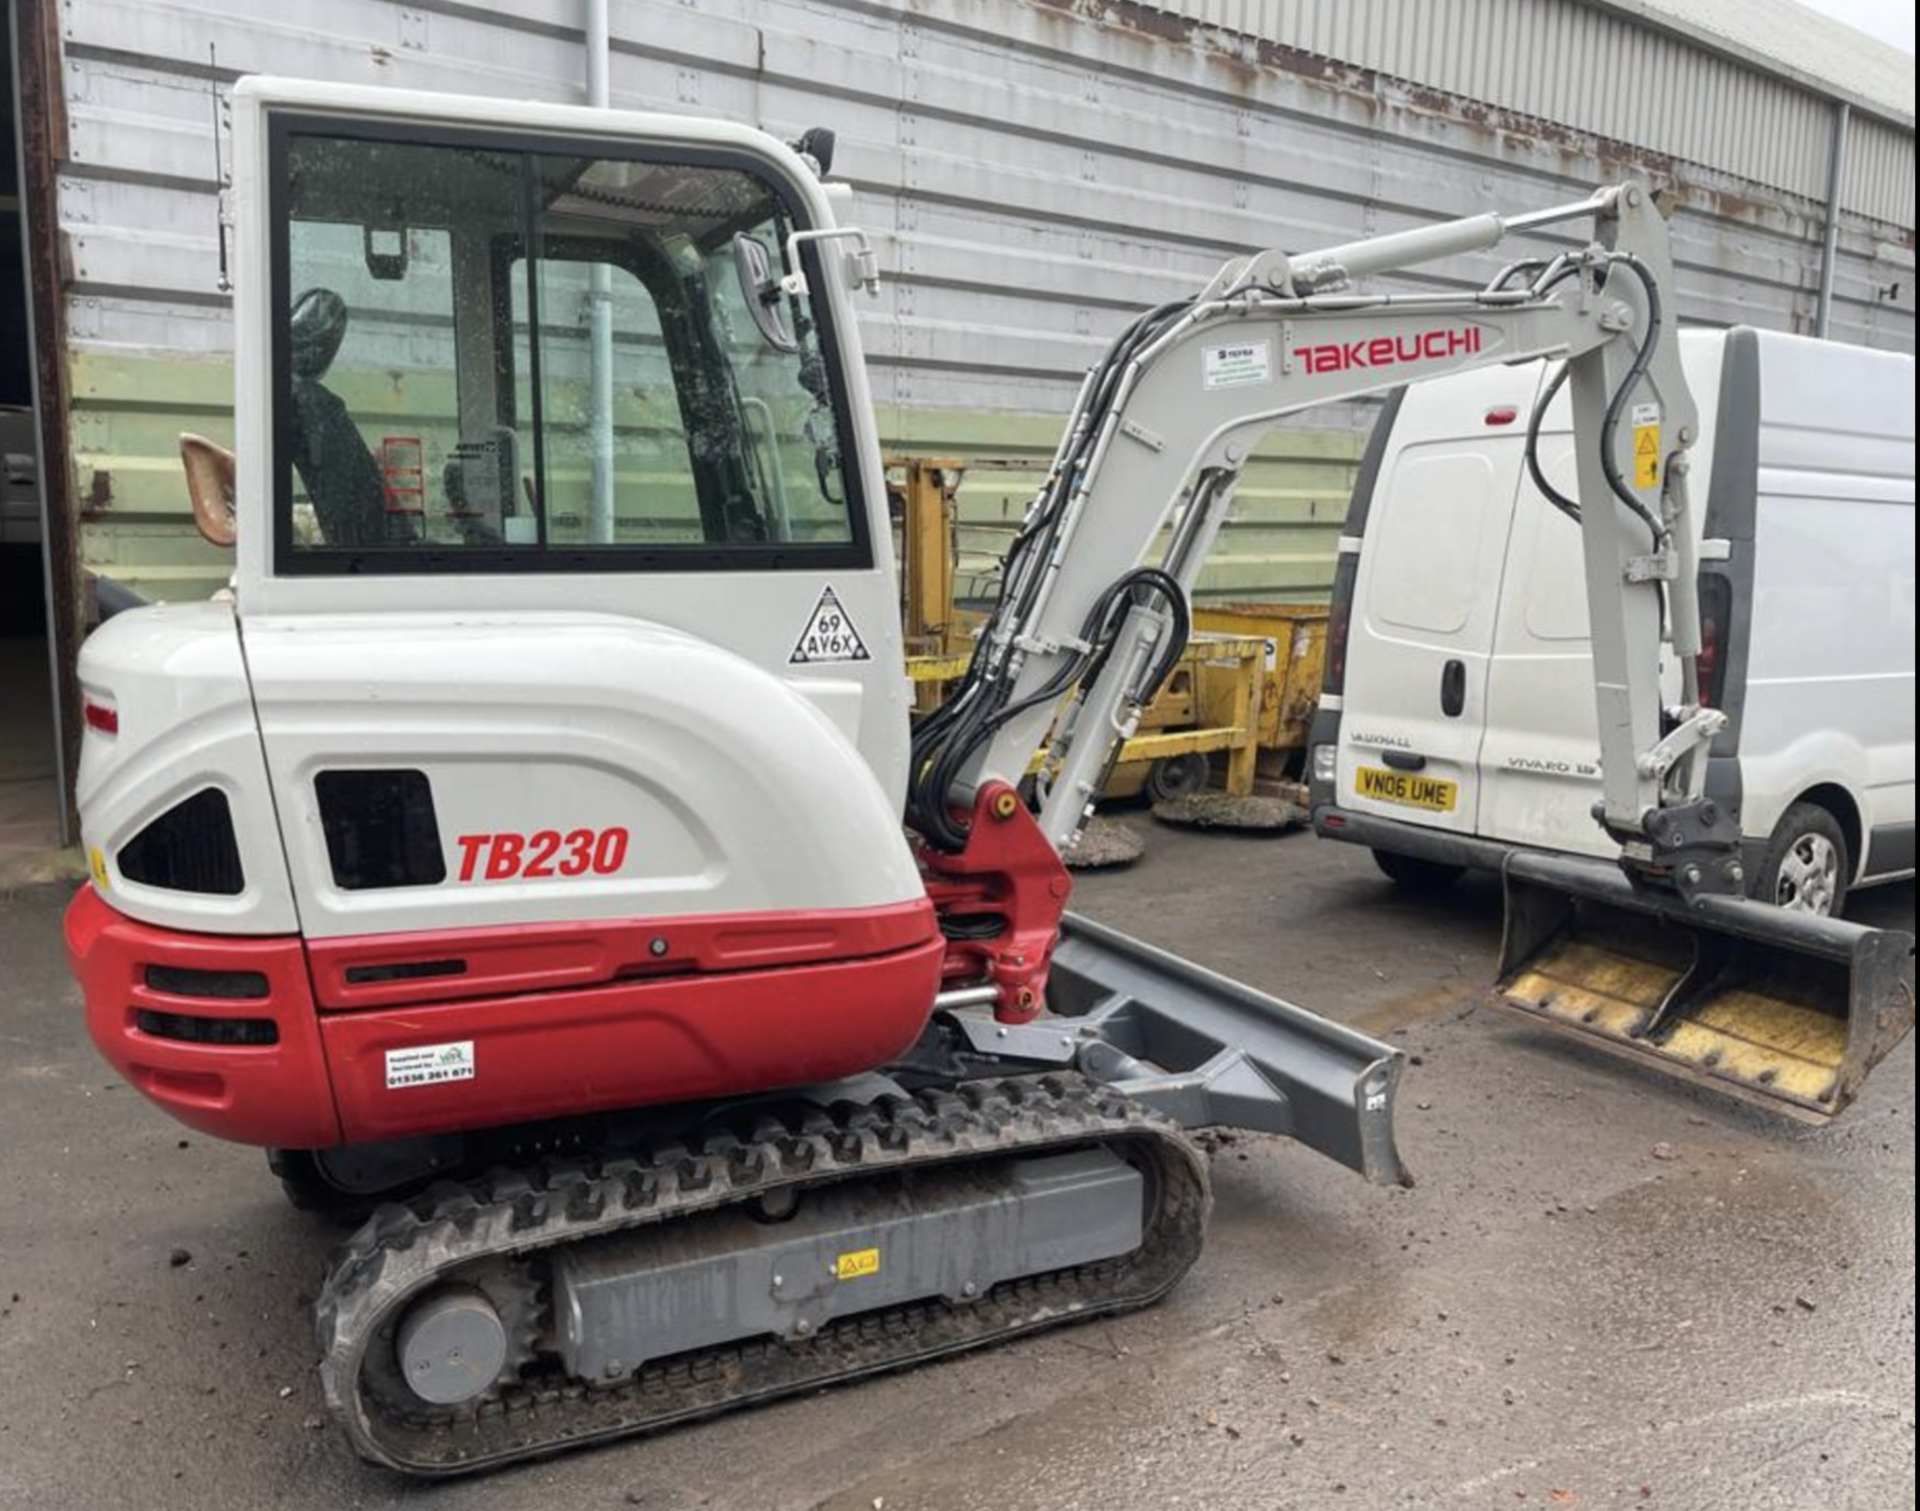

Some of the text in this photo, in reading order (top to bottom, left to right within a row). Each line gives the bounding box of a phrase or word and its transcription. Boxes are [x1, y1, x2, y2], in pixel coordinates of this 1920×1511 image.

[1293, 327, 1480, 375] TAKEUCHI
[818, 614, 841, 634] 69
[1350, 732, 1412, 749] VAUXHALL
[1508, 757, 1570, 773] VIVARO
[1364, 770, 1449, 806] VN06 UME
[457, 826, 630, 882] TB230
